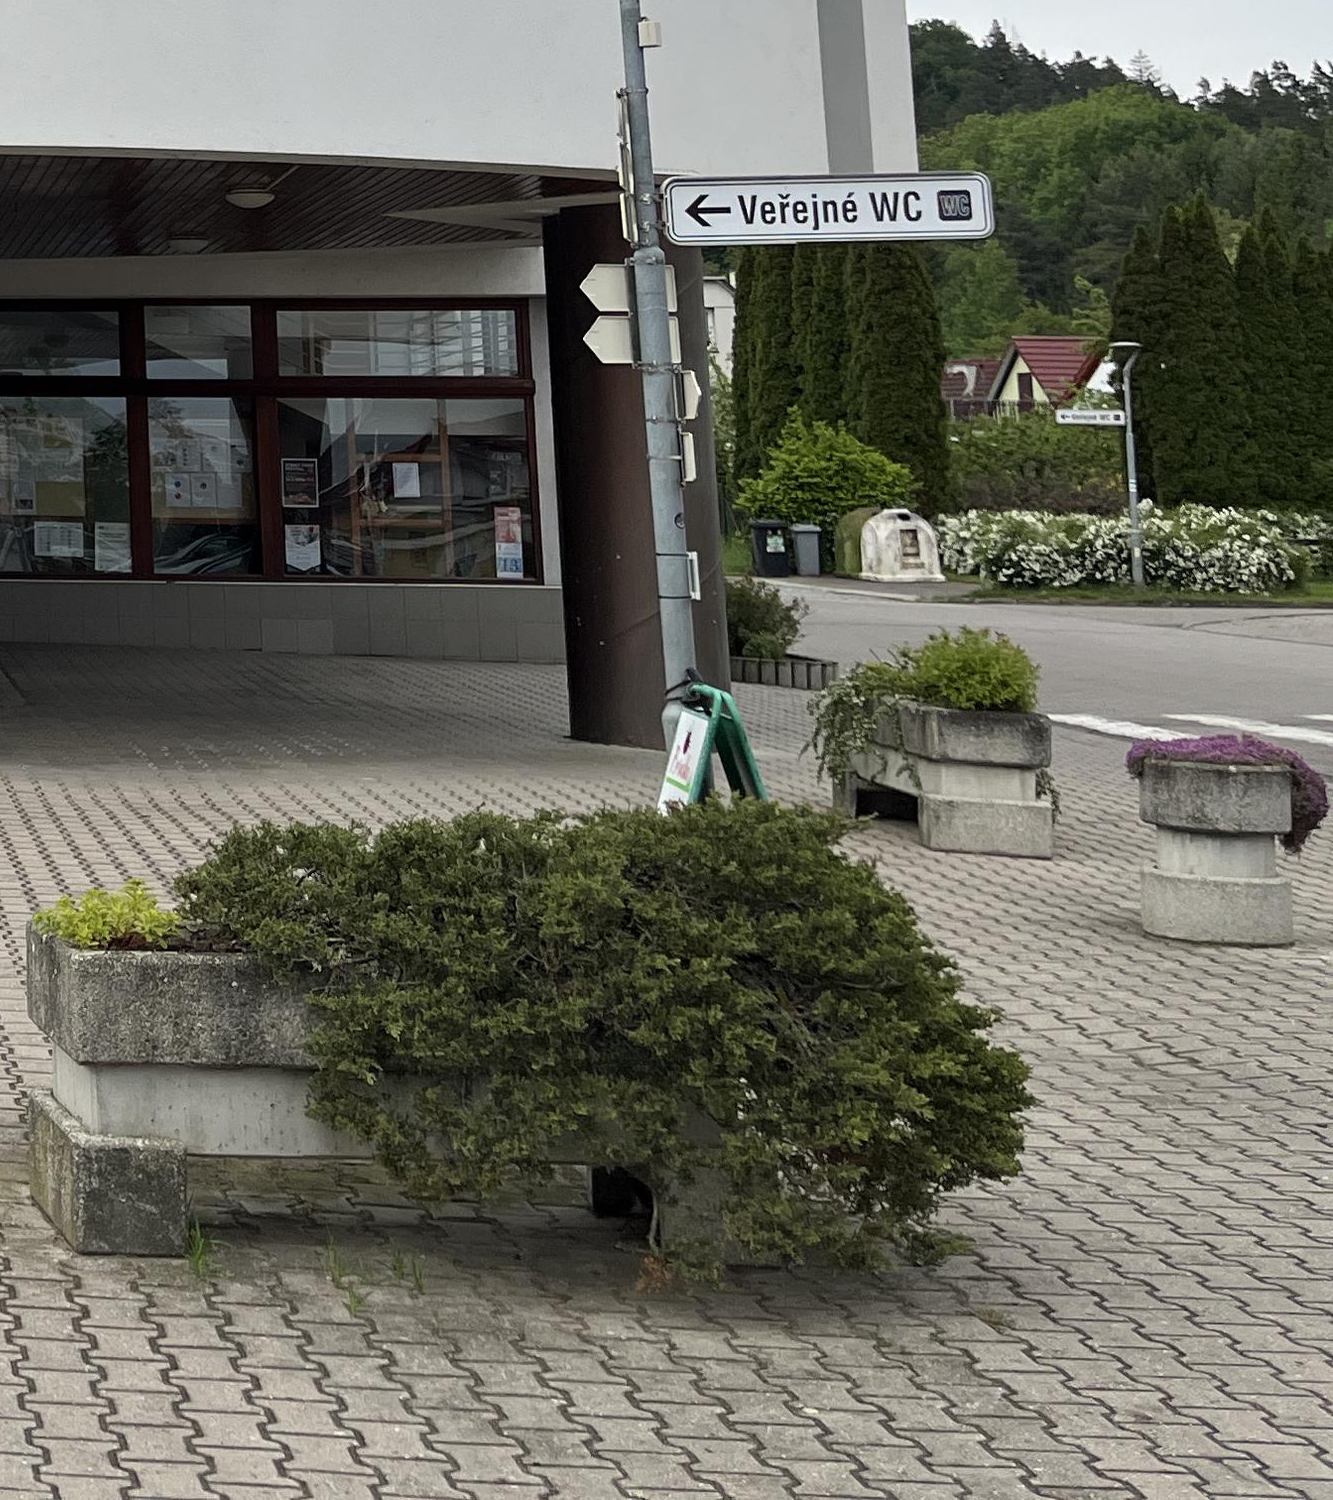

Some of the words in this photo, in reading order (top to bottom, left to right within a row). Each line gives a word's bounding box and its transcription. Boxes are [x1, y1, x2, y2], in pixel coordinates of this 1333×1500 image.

[737, 192, 858, 231] Veřejné
[869, 190, 922, 222] WC
[939, 194, 970, 217] WC
